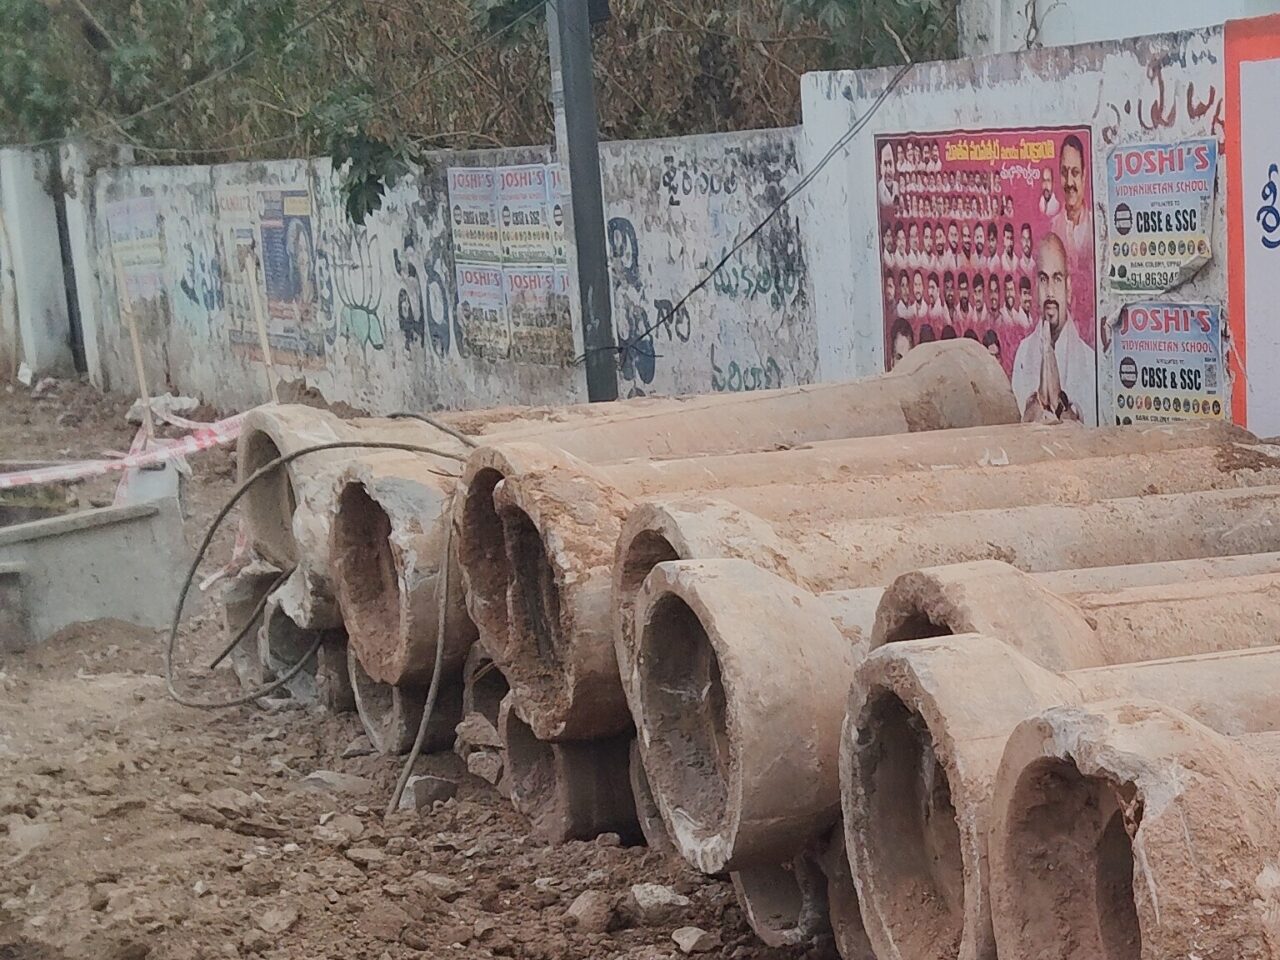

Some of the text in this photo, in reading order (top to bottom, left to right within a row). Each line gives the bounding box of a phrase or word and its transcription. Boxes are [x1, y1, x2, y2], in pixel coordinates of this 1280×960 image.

[1114, 145, 1209, 182] JOSHI'S
[1115, 180, 1208, 198] VIDYANIKETAN SCHOOL
[1136, 209, 1197, 233] CBSE & SSC
[1120, 308, 1211, 336] JOSHI'S
[1180, 341, 1213, 353] SCHOOL
[1141, 367, 1202, 391] CBSE & SSC
